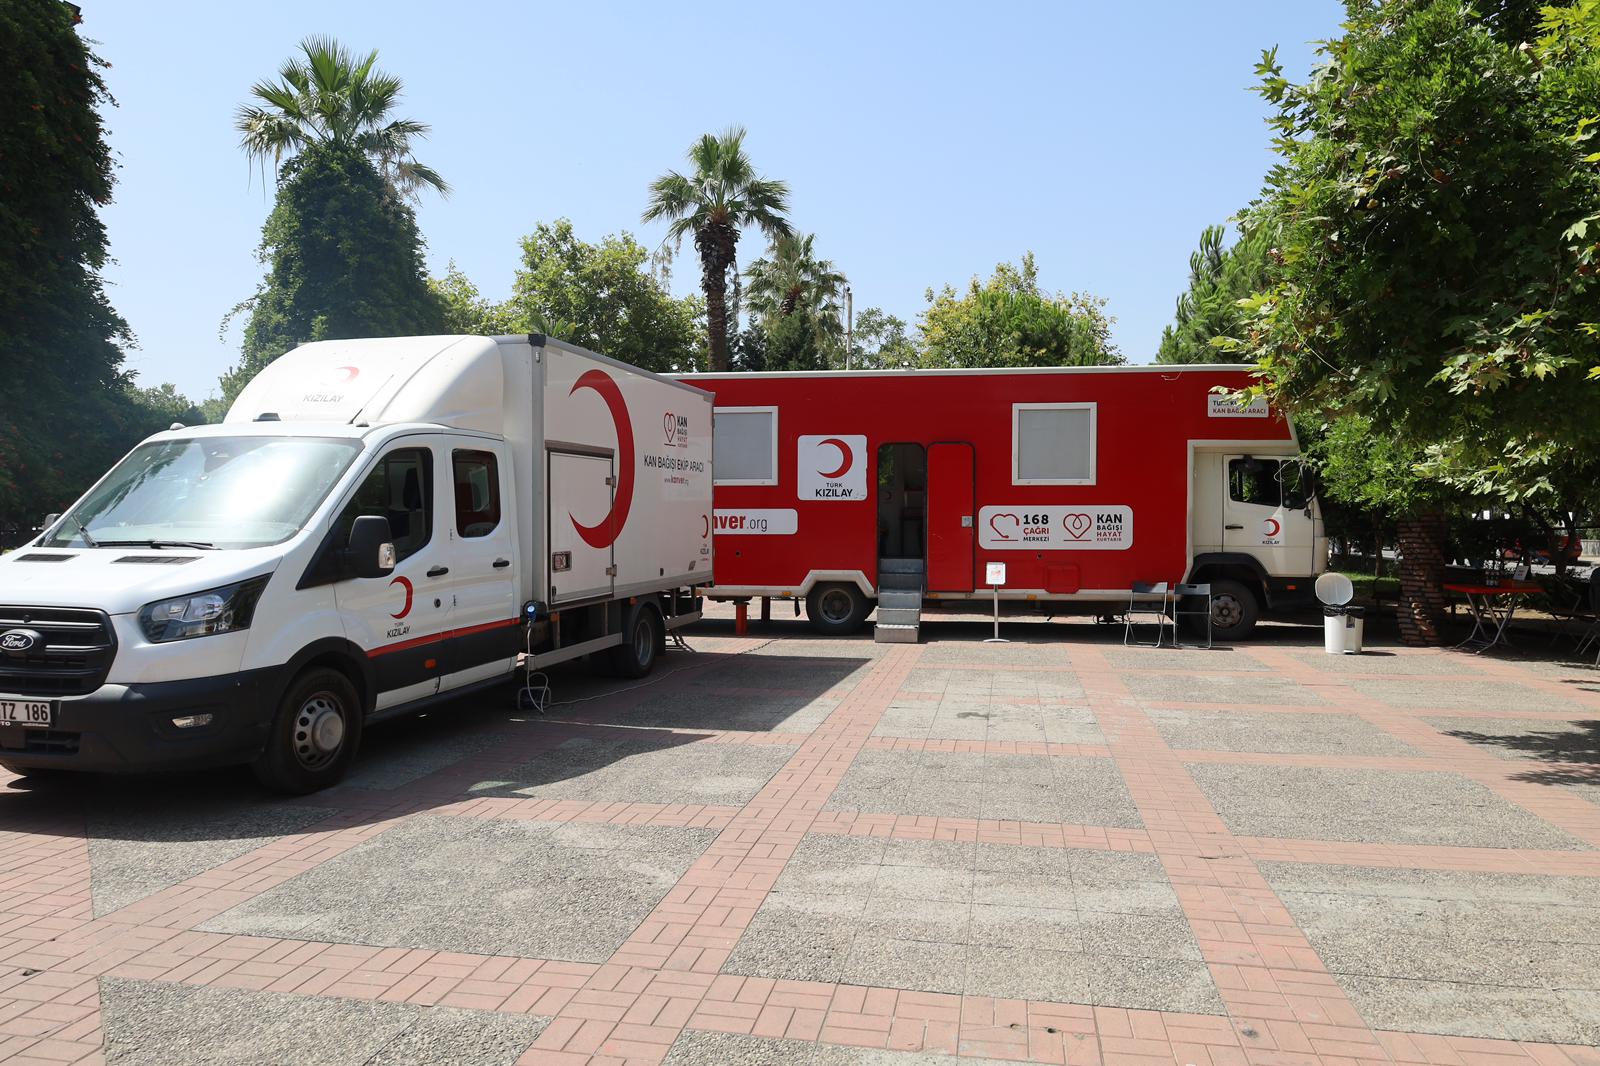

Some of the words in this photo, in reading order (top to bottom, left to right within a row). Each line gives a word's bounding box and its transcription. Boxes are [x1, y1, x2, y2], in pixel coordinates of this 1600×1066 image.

[677, 415, 688, 428] KAN
[644, 455, 657, 467] KAN
[657, 455, 677, 472] BAĞIŞI
[677, 457, 689, 471] EKİP
[815, 488, 853, 498] KIZILAY
[1023, 514, 1049, 525] 168
[1096, 514, 1122, 523] KAN
[1023, 526, 1049, 536] ÇAĞRI
[1096, 524, 1122, 532] BAĞIŞI
[387, 625, 411, 638] KIZILAY
[2, 635, 26, 647] Ford
[25, 703, 49, 721] 186
